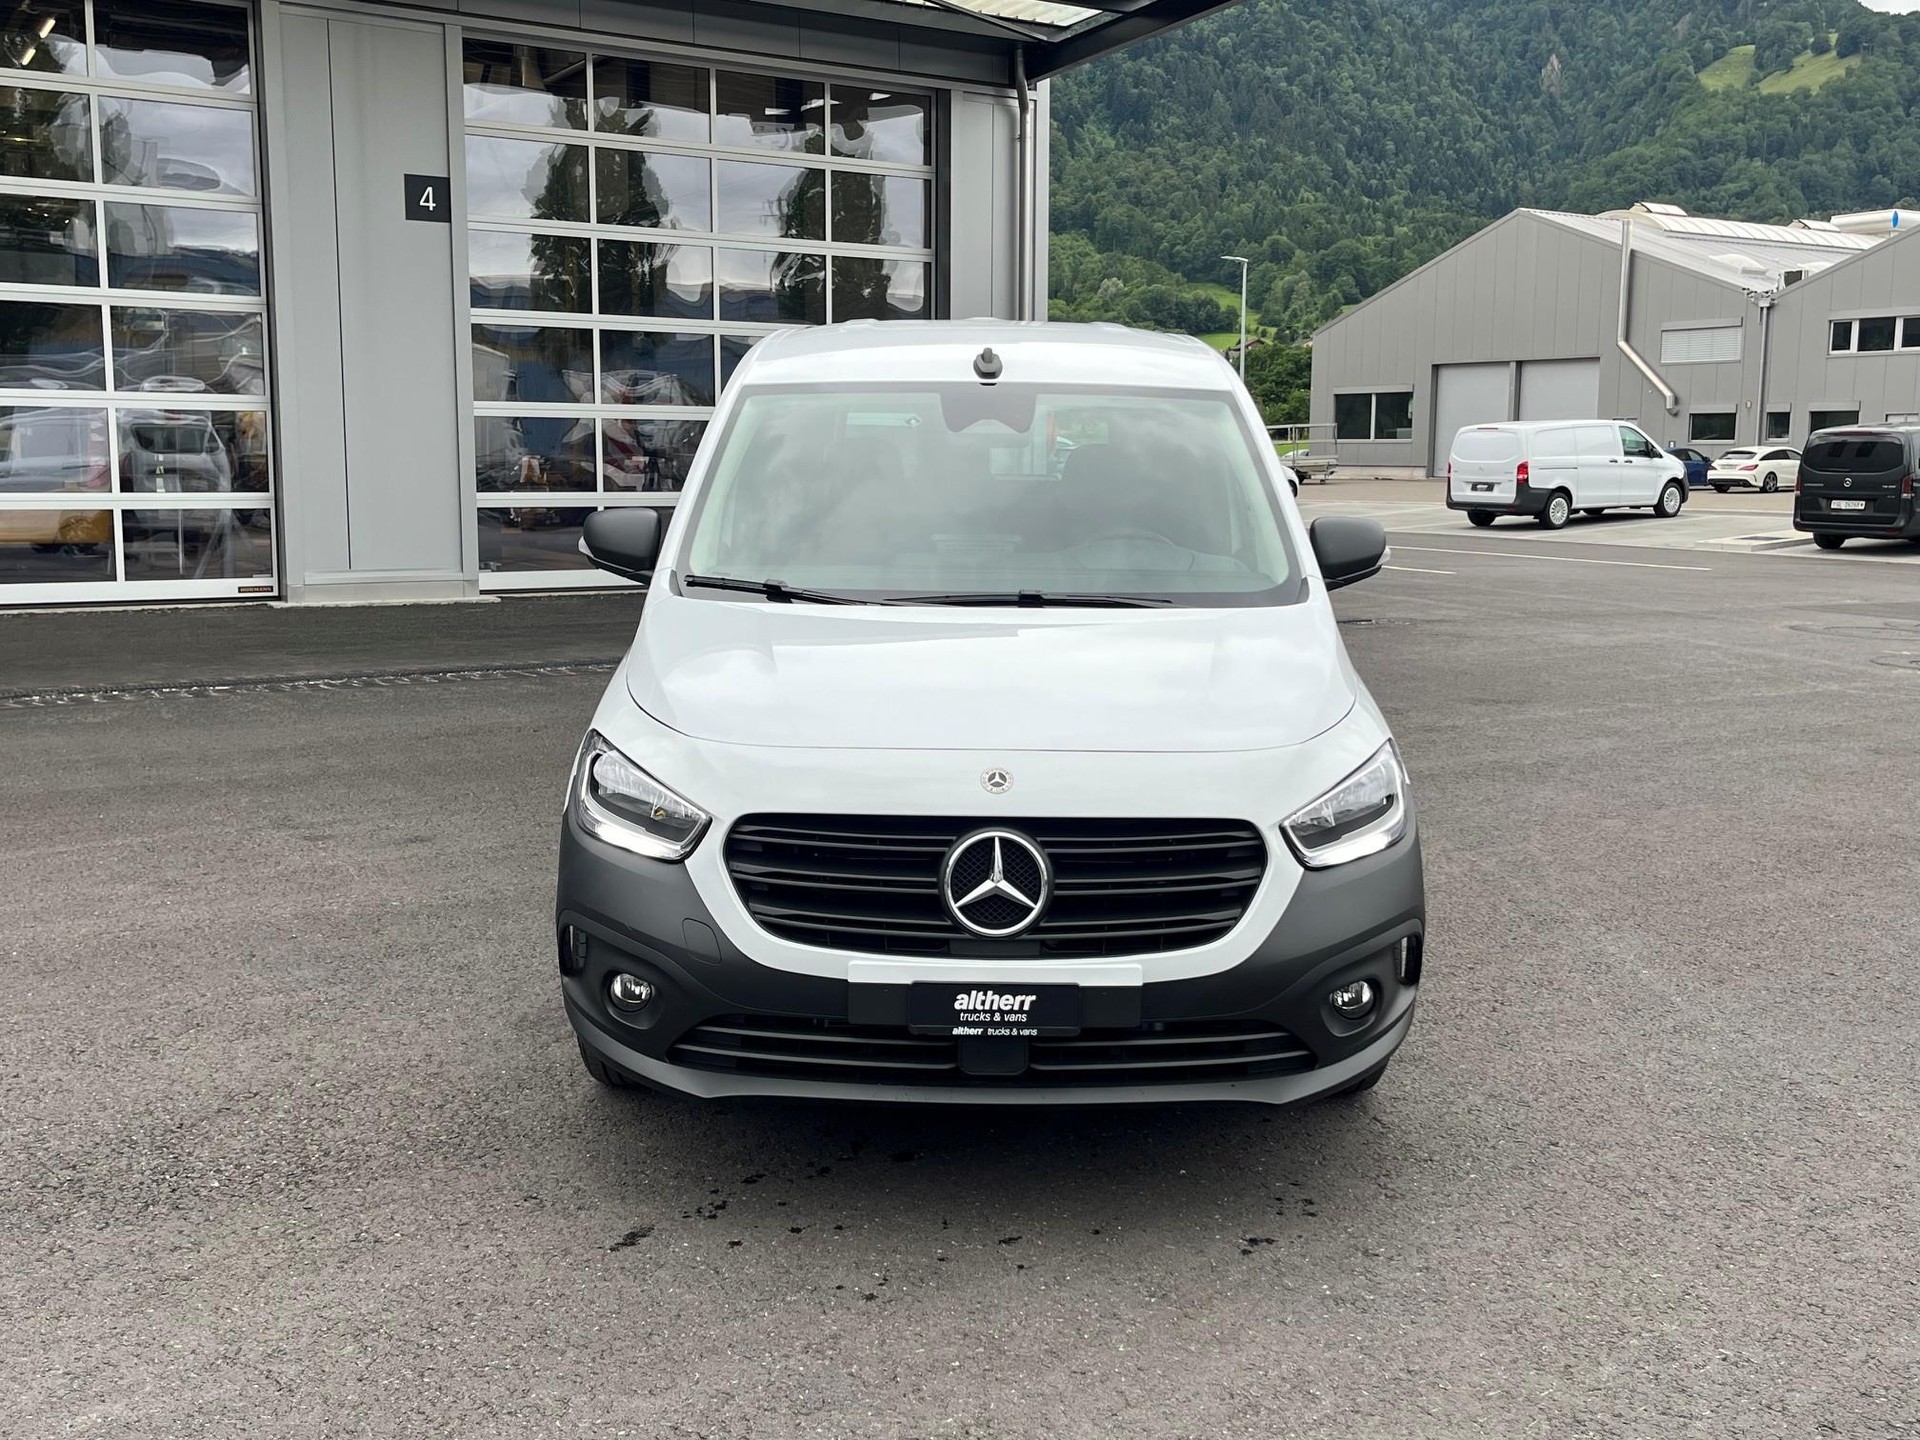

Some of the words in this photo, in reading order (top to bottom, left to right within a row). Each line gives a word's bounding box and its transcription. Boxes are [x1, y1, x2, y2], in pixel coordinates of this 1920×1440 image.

[419, 186, 437, 211] 4
[953, 990, 1037, 1011] altherr
[959, 1011, 991, 1022] trucks
[993, 1012, 1001, 1022] &
[1004, 1013, 1027, 1022] vans
[952, 1026, 984, 1035] altherr
[987, 1027, 1010, 1036] trucks
[1011, 1028, 1018, 1036] &
[1019, 1028, 1038, 1036] vans
